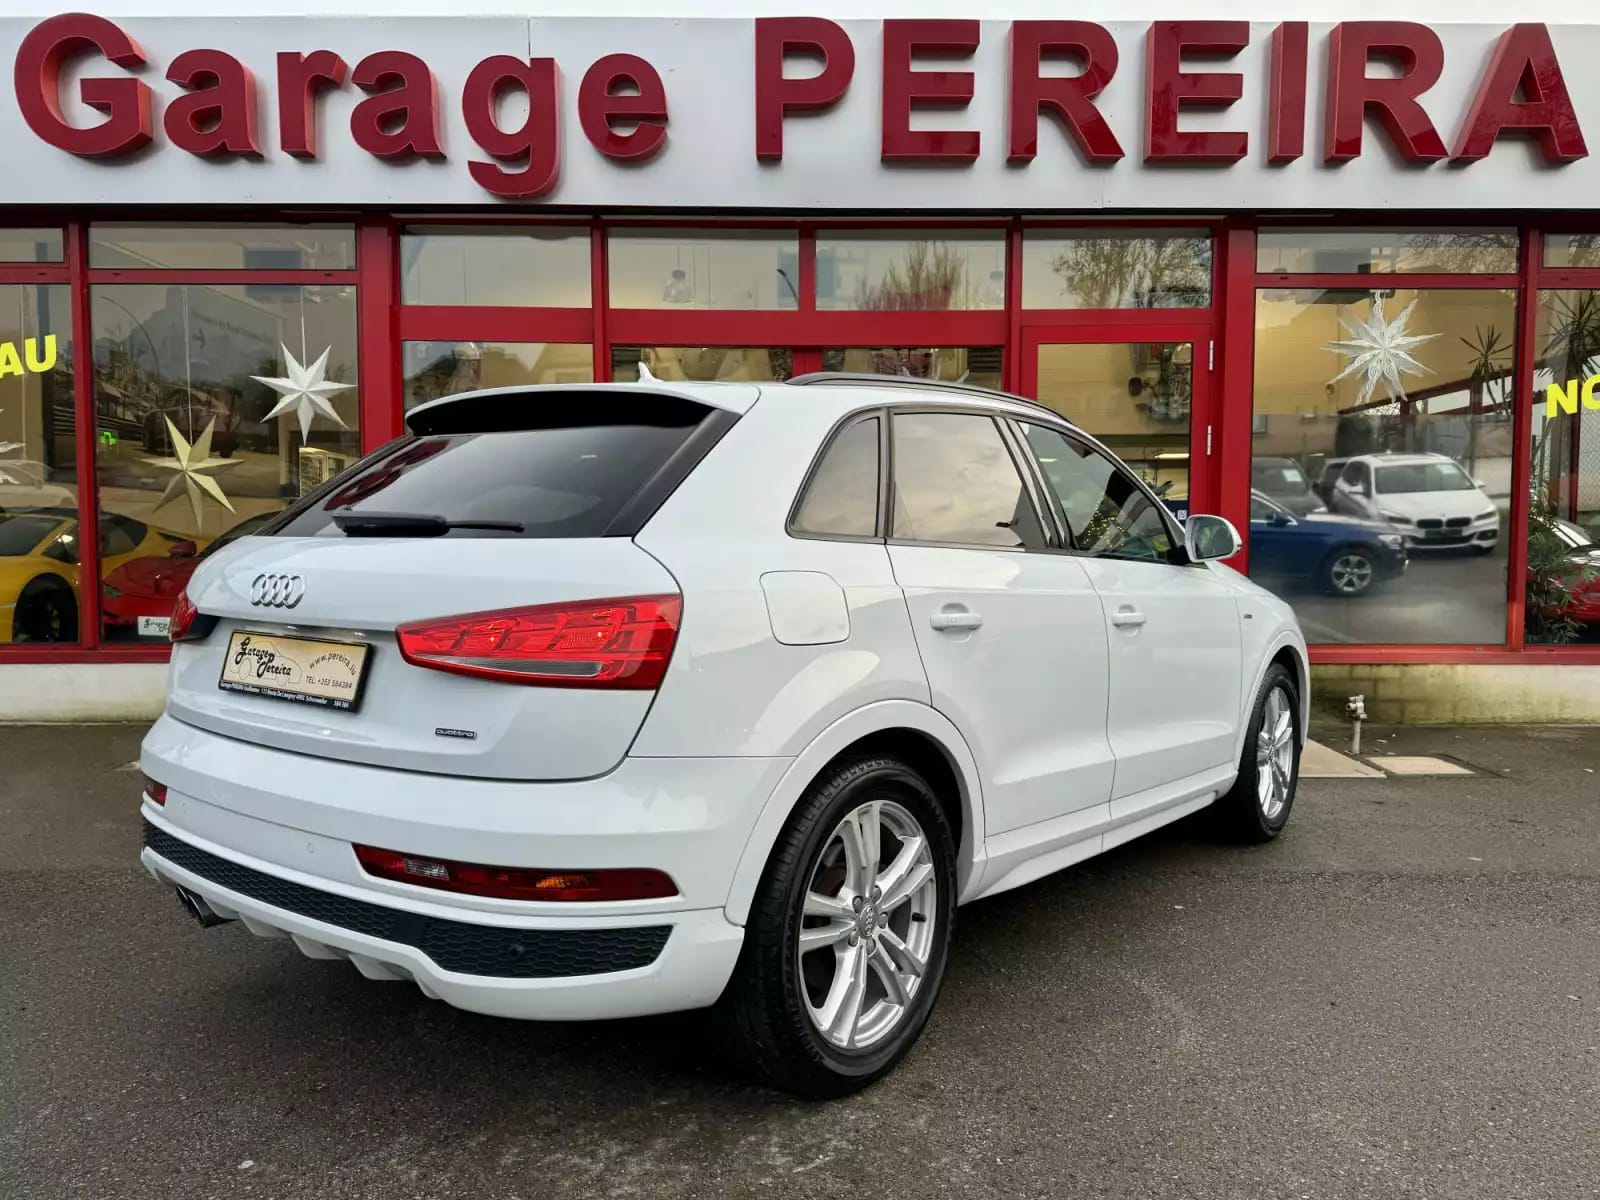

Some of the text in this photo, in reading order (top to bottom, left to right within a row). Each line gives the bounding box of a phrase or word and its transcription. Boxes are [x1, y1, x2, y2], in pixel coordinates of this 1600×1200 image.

[14, 12, 1589, 199] Garage PEREIRA
[235, 636, 269, 665] Garage
[256, 653, 292, 678] Pereira
[309, 652, 357, 676] www.pereira.lu
[436, 729, 474, 738] quattro
